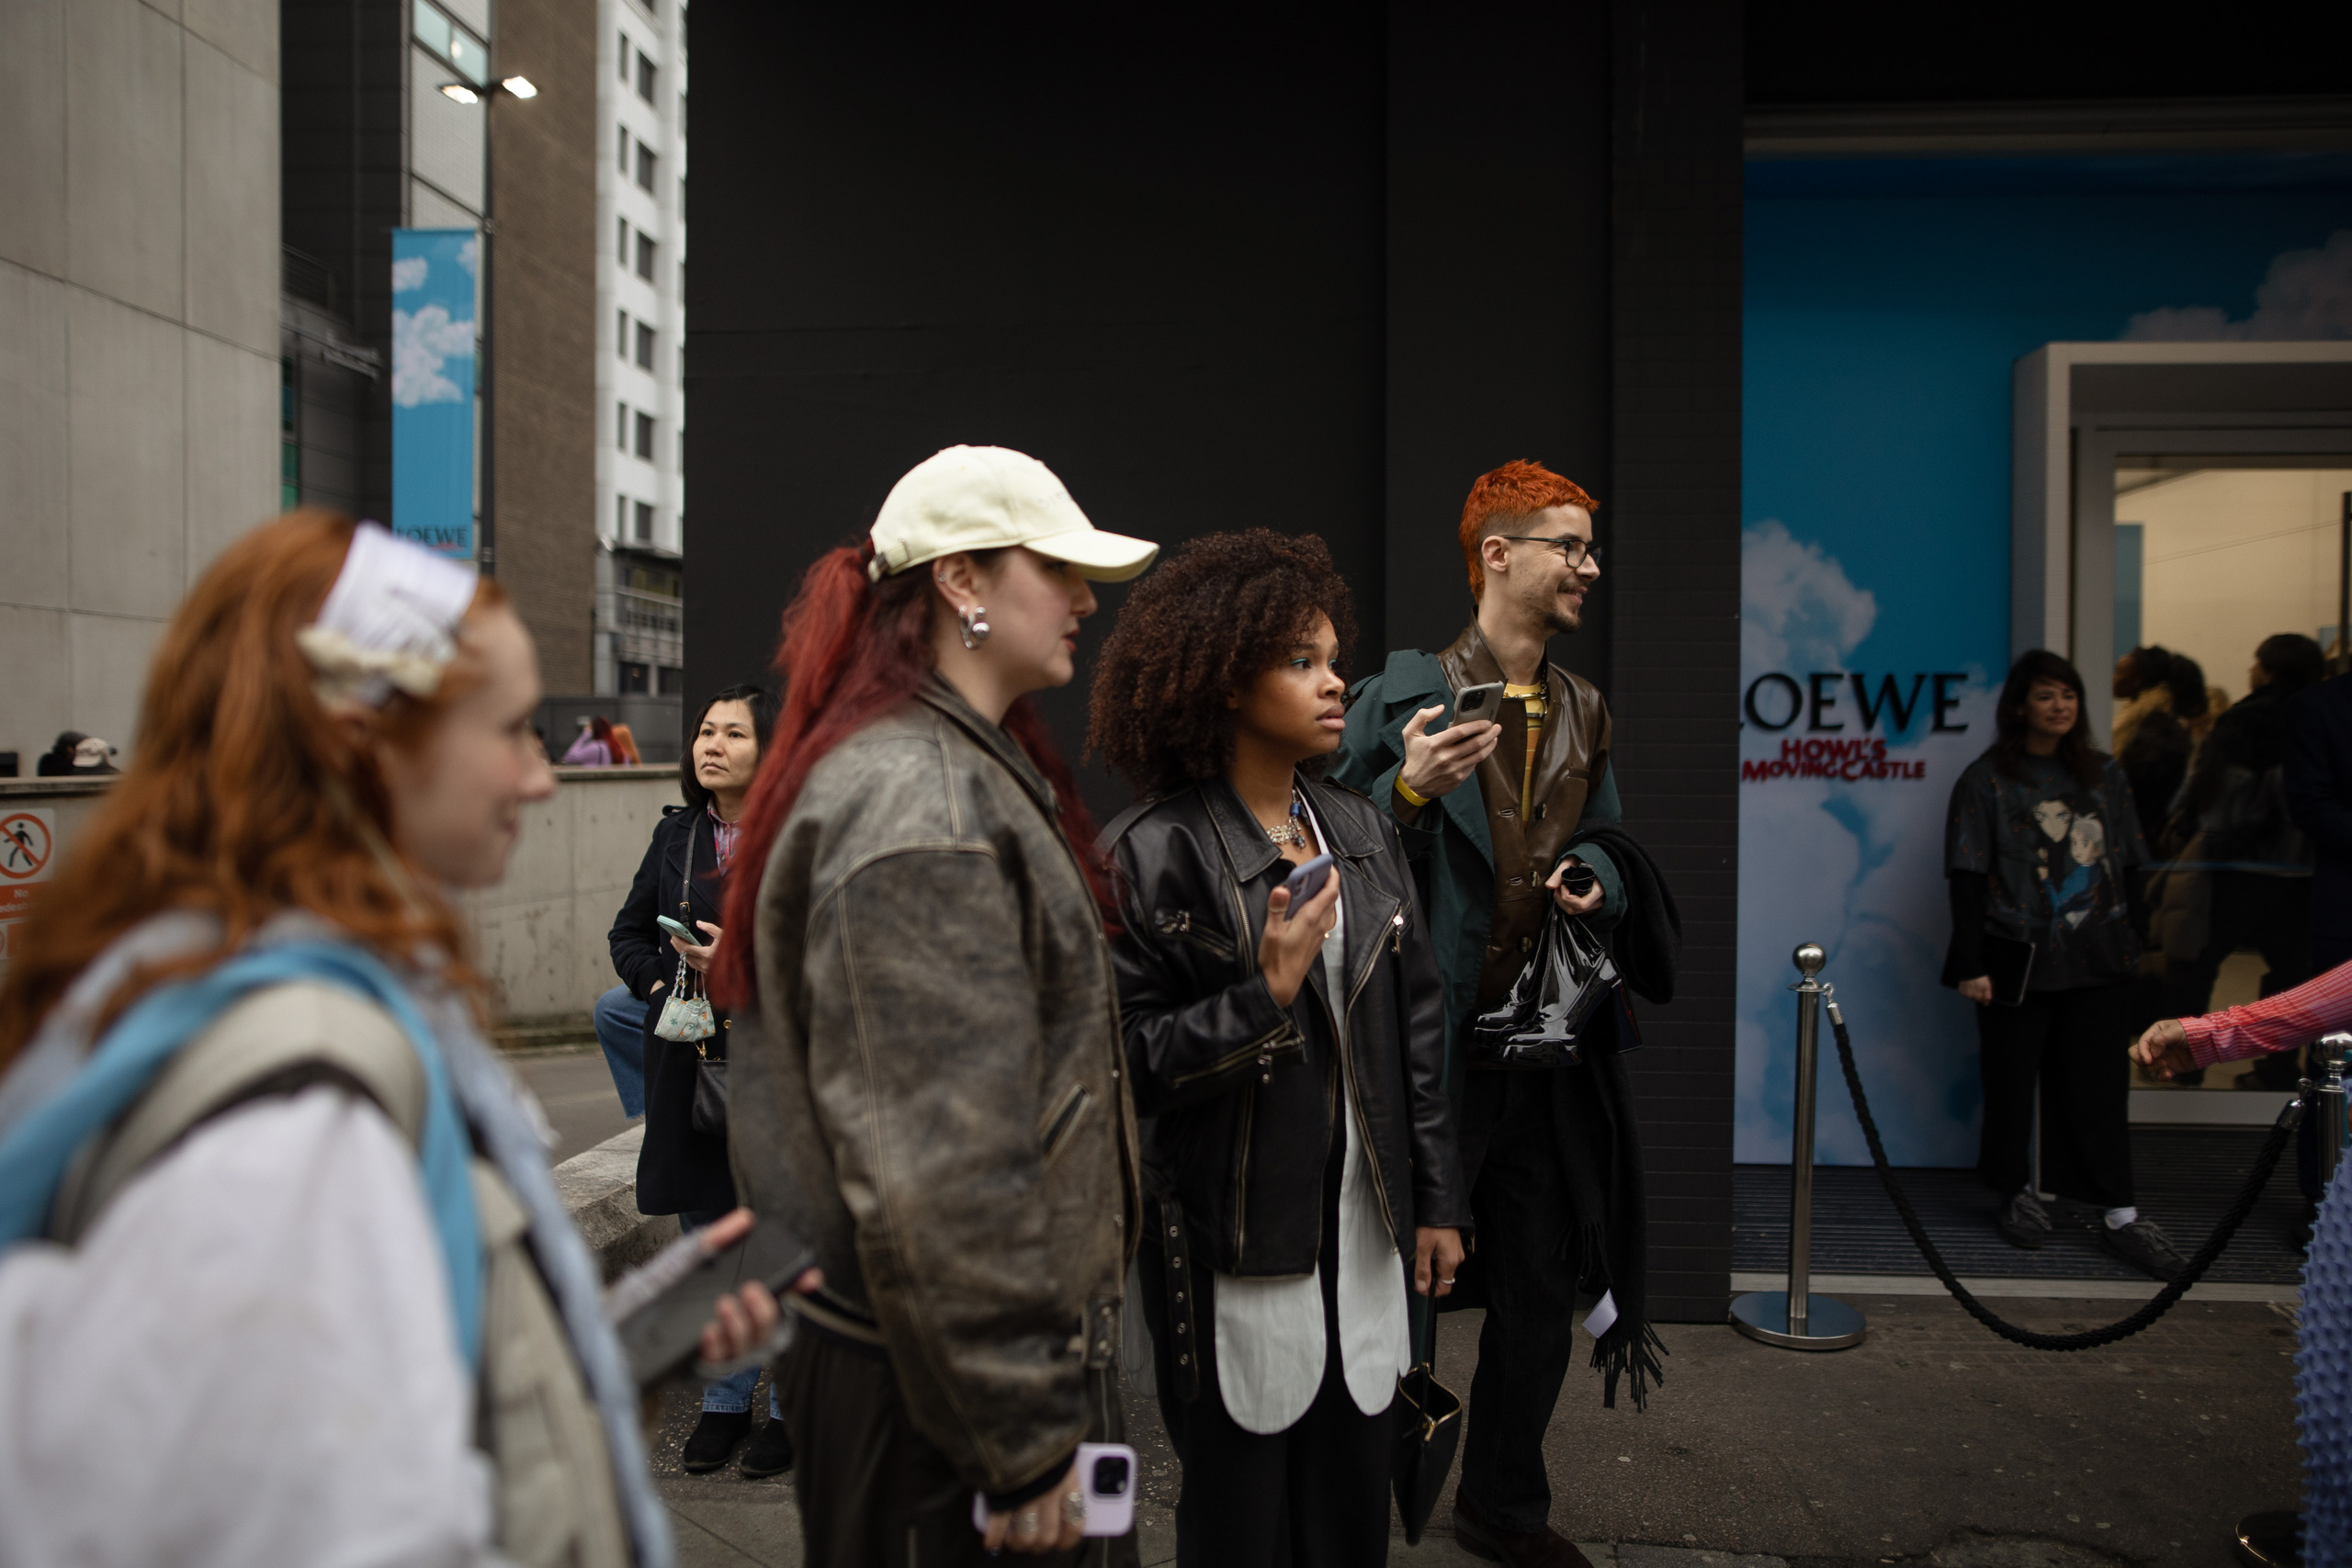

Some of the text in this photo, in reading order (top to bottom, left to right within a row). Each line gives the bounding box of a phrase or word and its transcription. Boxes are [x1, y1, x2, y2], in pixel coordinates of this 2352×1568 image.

[1740, 672, 1969, 732] OEWE
[1781, 738, 1888, 761] HOWL'S
[1742, 760, 1927, 781] MOVING CASTLE
[14, 888, 29, 898] No
